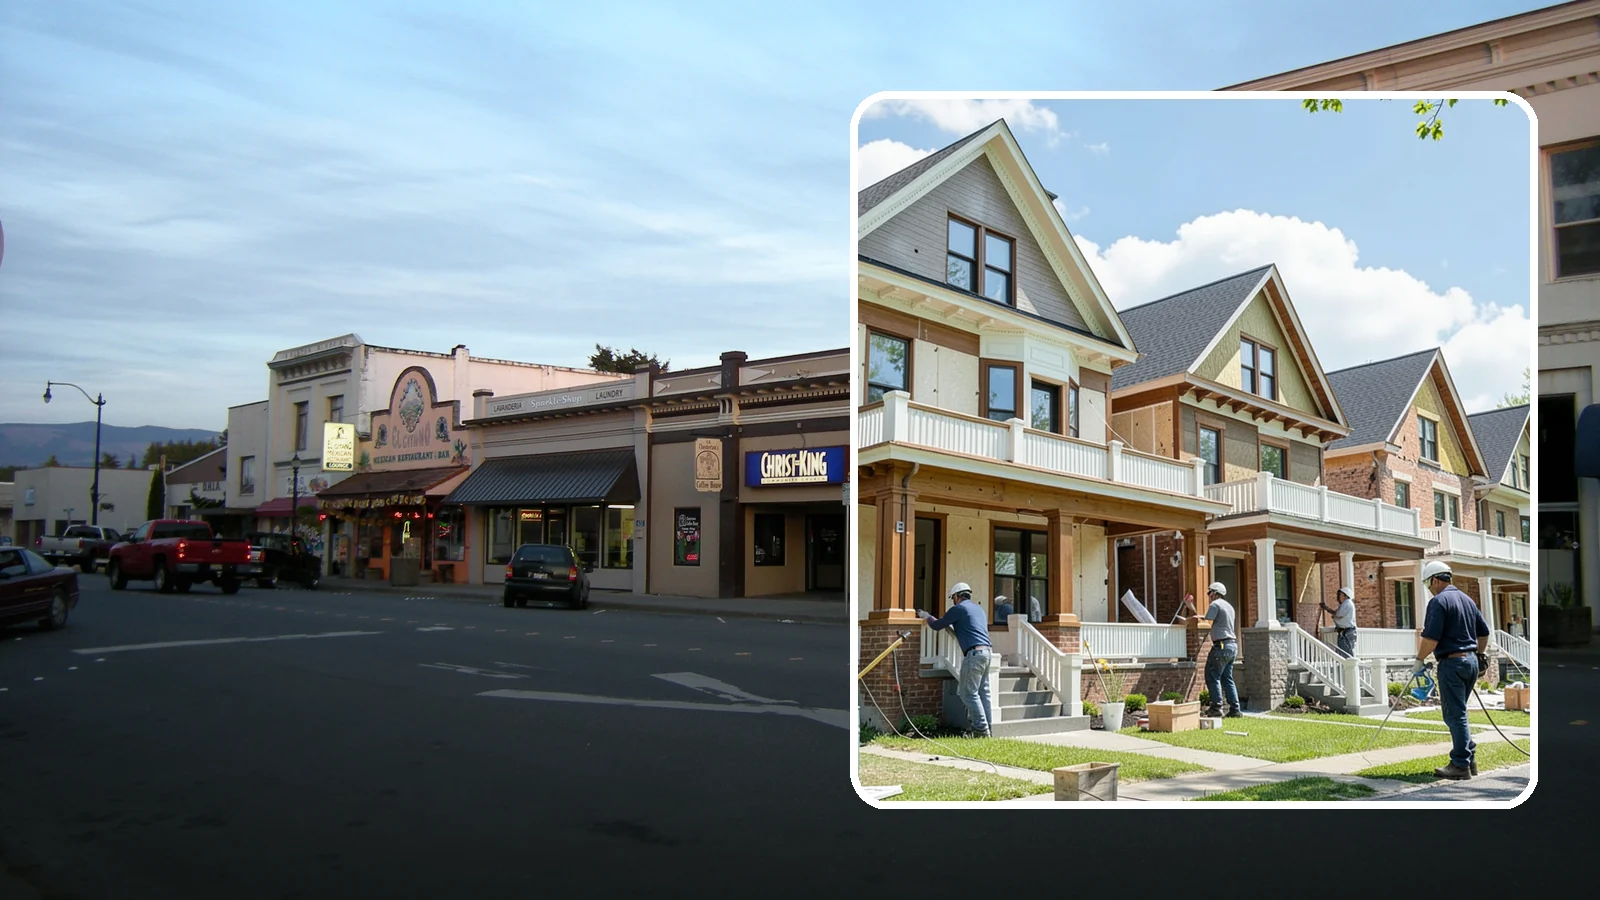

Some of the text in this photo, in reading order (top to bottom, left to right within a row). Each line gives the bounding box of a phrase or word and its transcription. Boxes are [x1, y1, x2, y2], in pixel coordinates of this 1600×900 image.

[493, 389, 624, 413] LAVANDERIA Sparkle Shop LAUNDRY
[373, 454, 397, 464] MEXICAN
[397, 451, 433, 462] RESTAURANT
[438, 450, 450, 459] BAR
